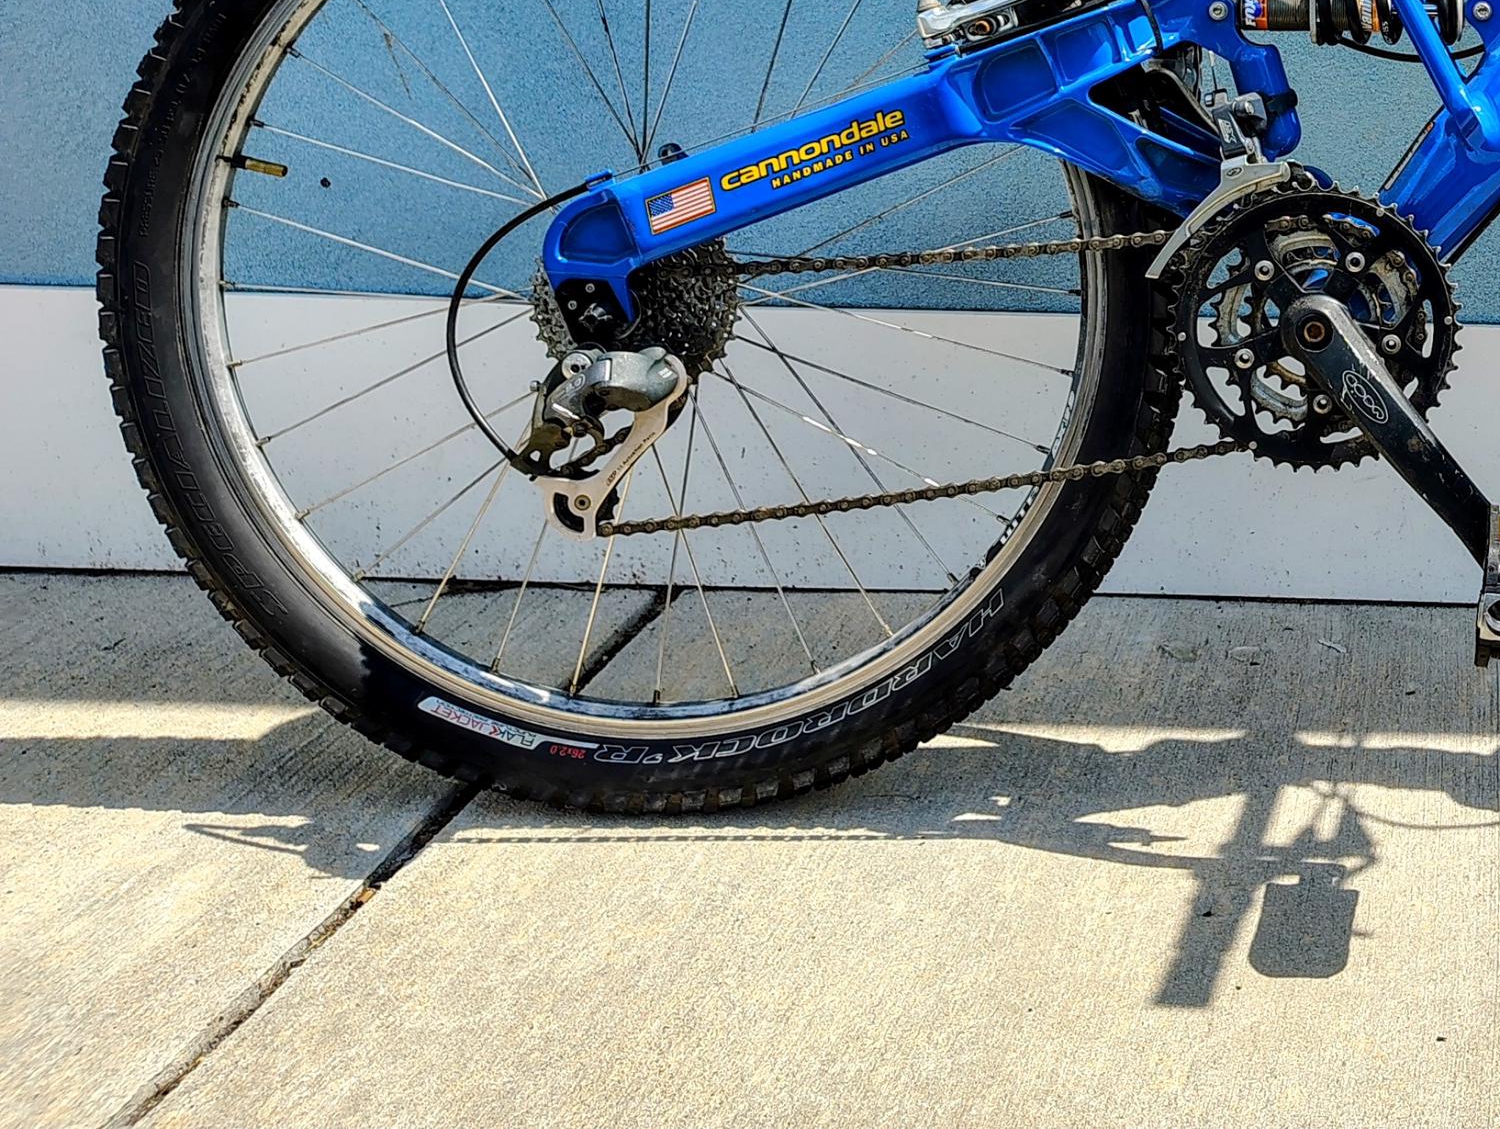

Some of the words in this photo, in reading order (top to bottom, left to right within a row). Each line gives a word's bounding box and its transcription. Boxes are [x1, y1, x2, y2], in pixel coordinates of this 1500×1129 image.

[720, 109, 906, 191] cannondale
[772, 151, 853, 189] HANDMADE
[859, 142, 875, 155] IN
[880, 129, 910, 147] USA
[132, 260, 287, 620] SPECIALIZED
[431, 705, 488, 733] JACKET
[550, 744, 585, 760] 26x2.0
